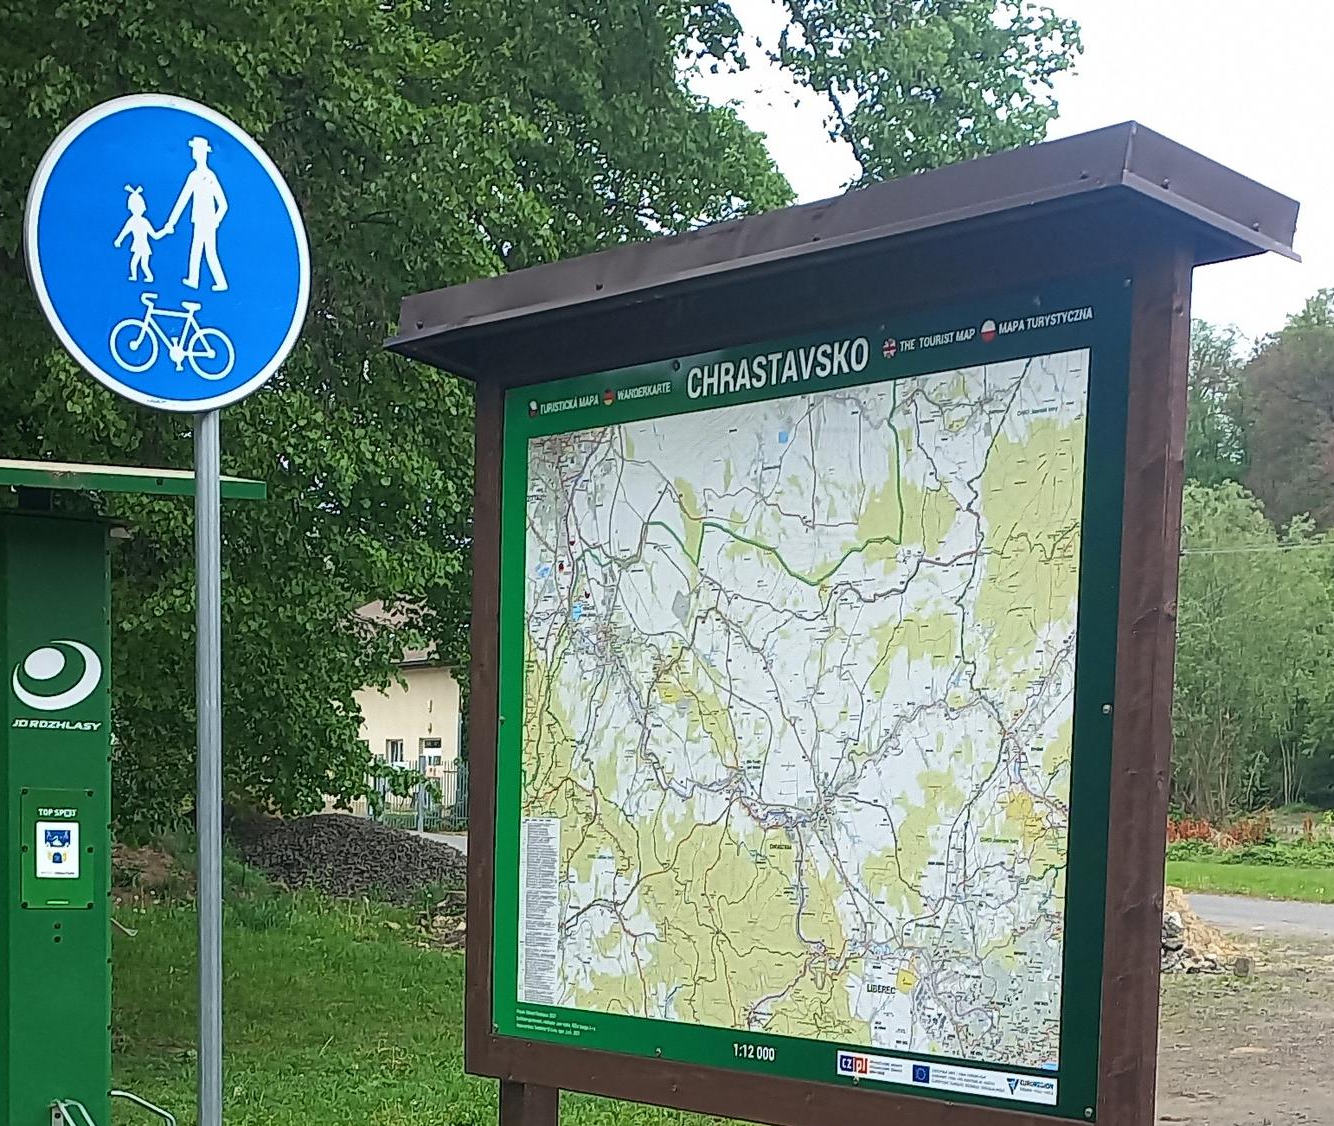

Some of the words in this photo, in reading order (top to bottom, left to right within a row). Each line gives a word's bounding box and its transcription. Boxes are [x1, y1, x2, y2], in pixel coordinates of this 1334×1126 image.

[999, 321, 1025, 335] MAPA
[1027, 307, 1093, 329] TURYSTYCZNA
[900, 339, 916, 351] THE
[919, 331, 954, 350] TOURIST
[956, 328, 976, 342] MAP
[685, 337, 870, 399] CHRASTAVSKO
[617, 381, 671, 401] WANDERKARTE
[540, 396, 578, 415] TURISTICKÁ
[579, 394, 599, 409] MAPA
[29, 720, 102, 731] ROZHLASY
[38, 808, 53, 817] TOP
[867, 984, 896, 995] LIBEREC
[733, 1043, 755, 1059] 1:12
[755, 1044, 775, 1061] 000
